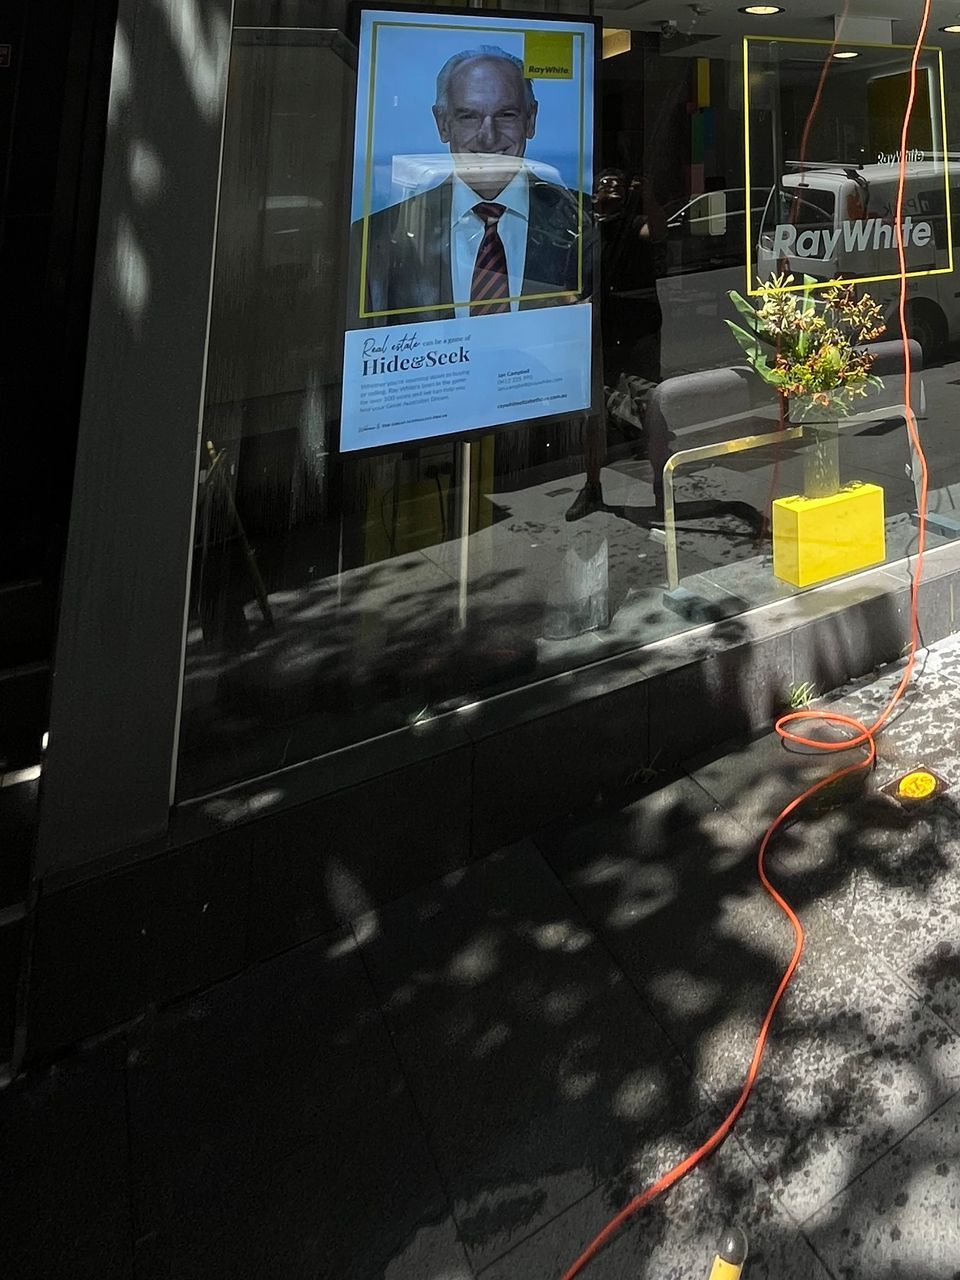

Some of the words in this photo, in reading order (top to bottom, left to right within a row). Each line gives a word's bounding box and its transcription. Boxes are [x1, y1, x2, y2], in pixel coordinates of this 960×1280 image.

[362, 334, 390, 359] Real
[391, 332, 421, 352] estate
[362, 346, 470, 376] Hide&Seek
